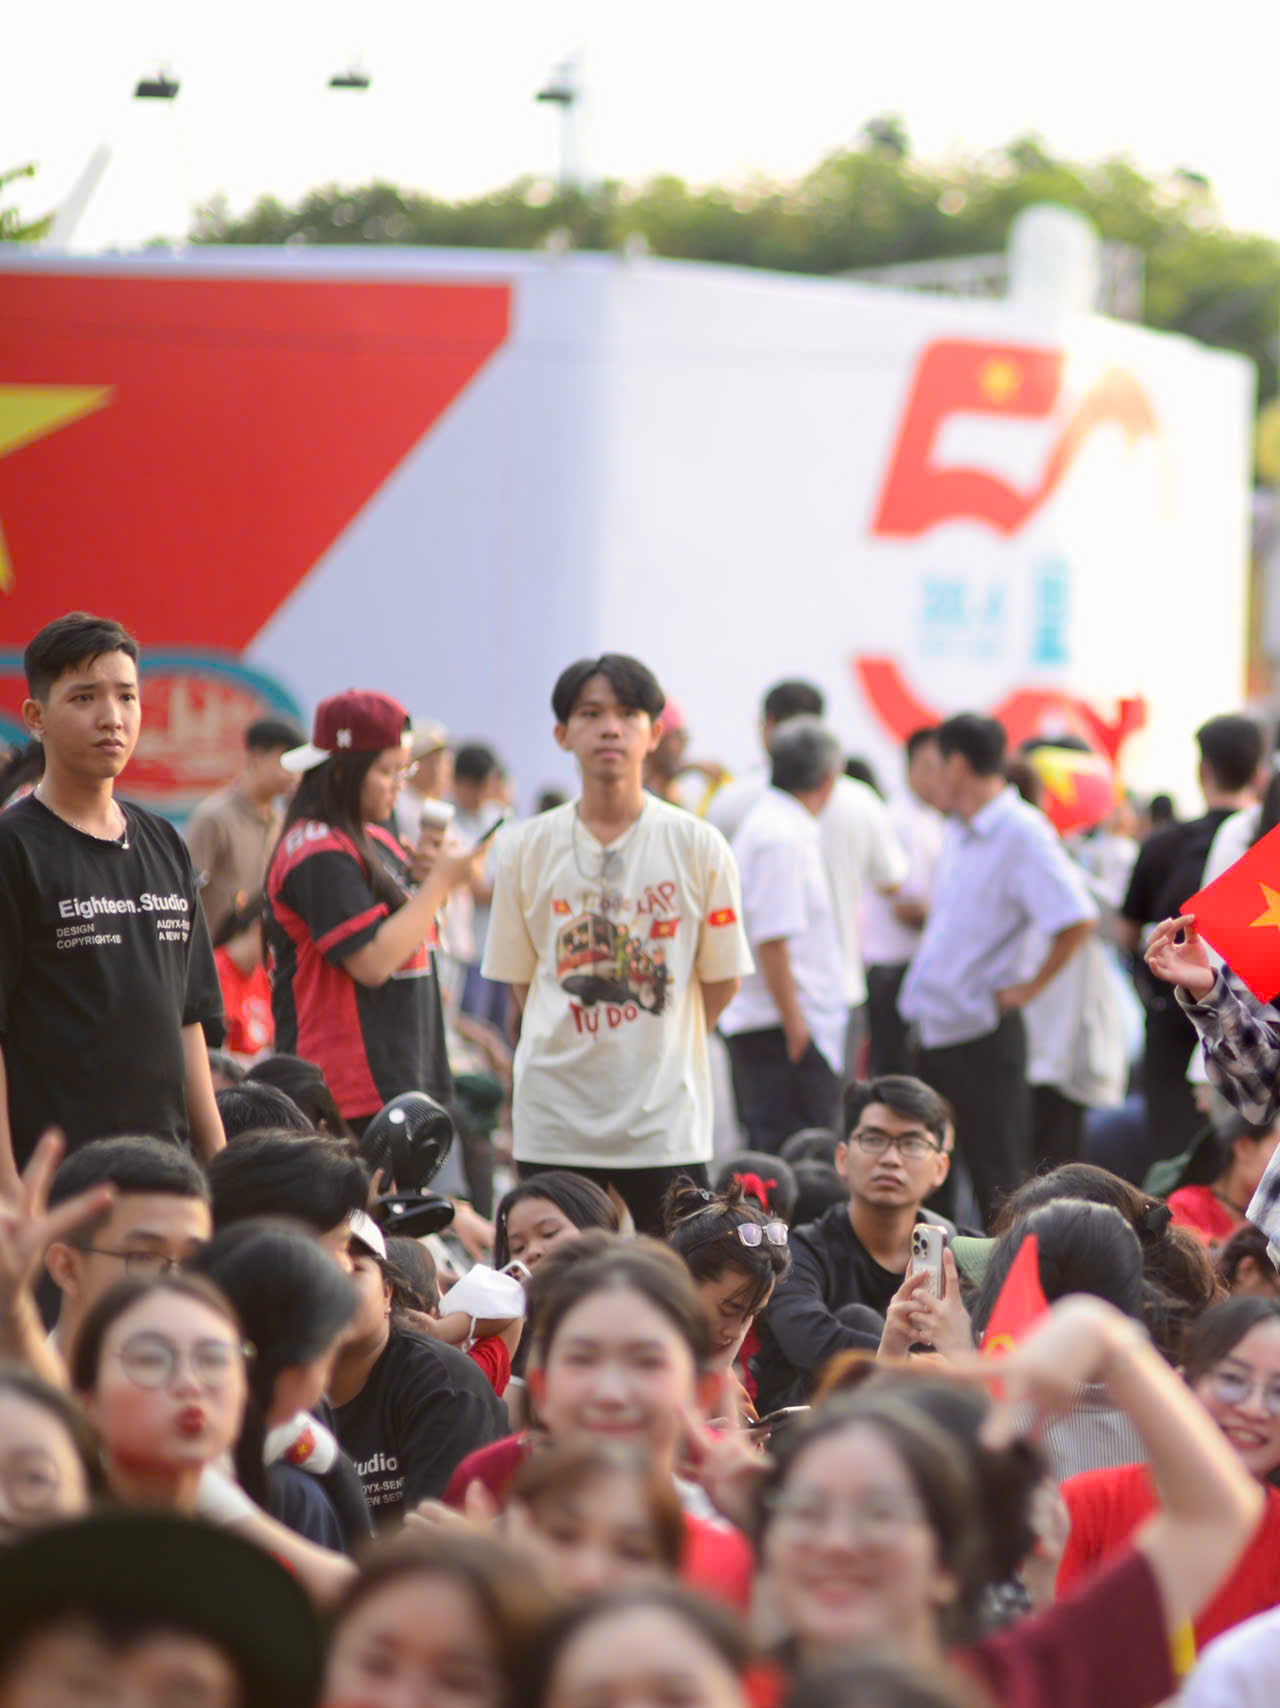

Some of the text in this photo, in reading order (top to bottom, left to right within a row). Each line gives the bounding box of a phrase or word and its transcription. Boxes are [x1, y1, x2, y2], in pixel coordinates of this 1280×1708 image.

[56, 924, 95, 937] DESIGN
[56, 934, 122, 949] COPYRIGHT-18
[607, 1004, 637, 1029] DO
